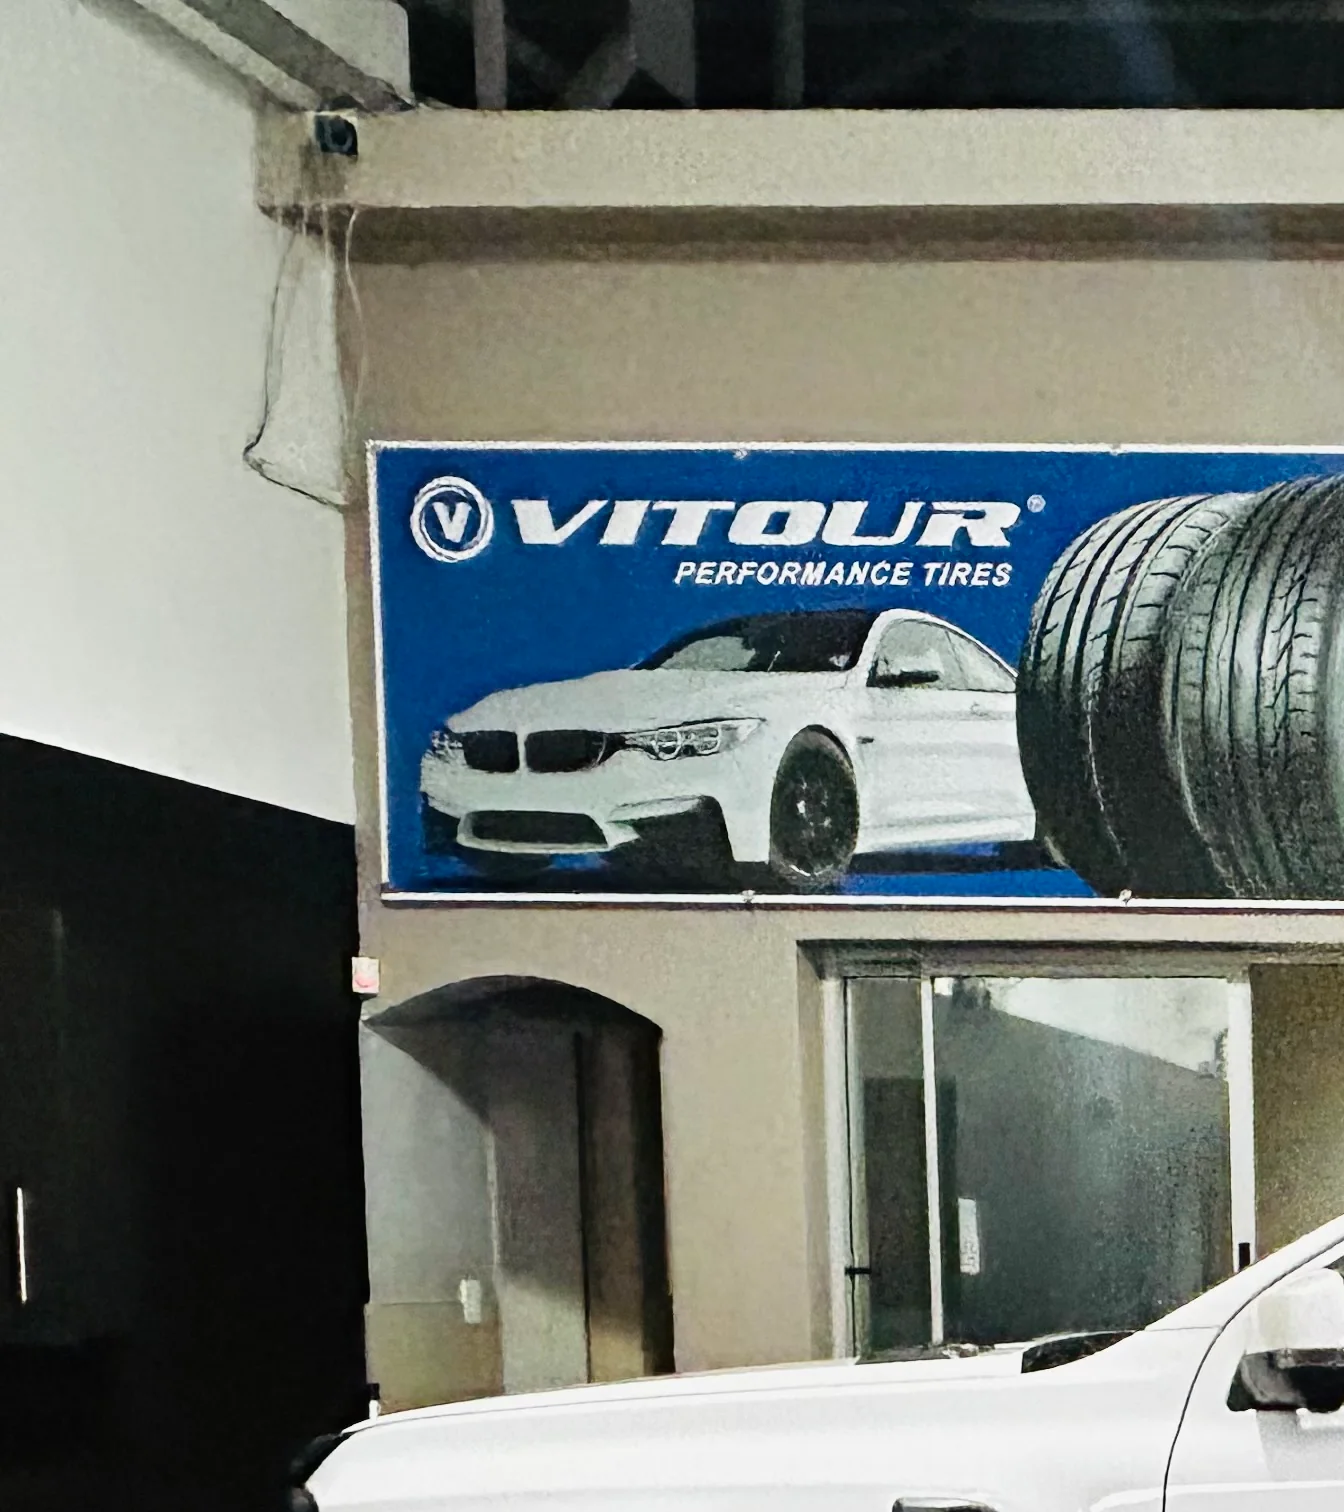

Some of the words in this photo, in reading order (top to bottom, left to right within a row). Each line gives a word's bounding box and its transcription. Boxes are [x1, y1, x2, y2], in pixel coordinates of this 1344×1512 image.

[511, 500, 1021, 546] VITOUR
[674, 561, 912, 588] PERFORMANCE
[922, 562, 1014, 588] TIRES
